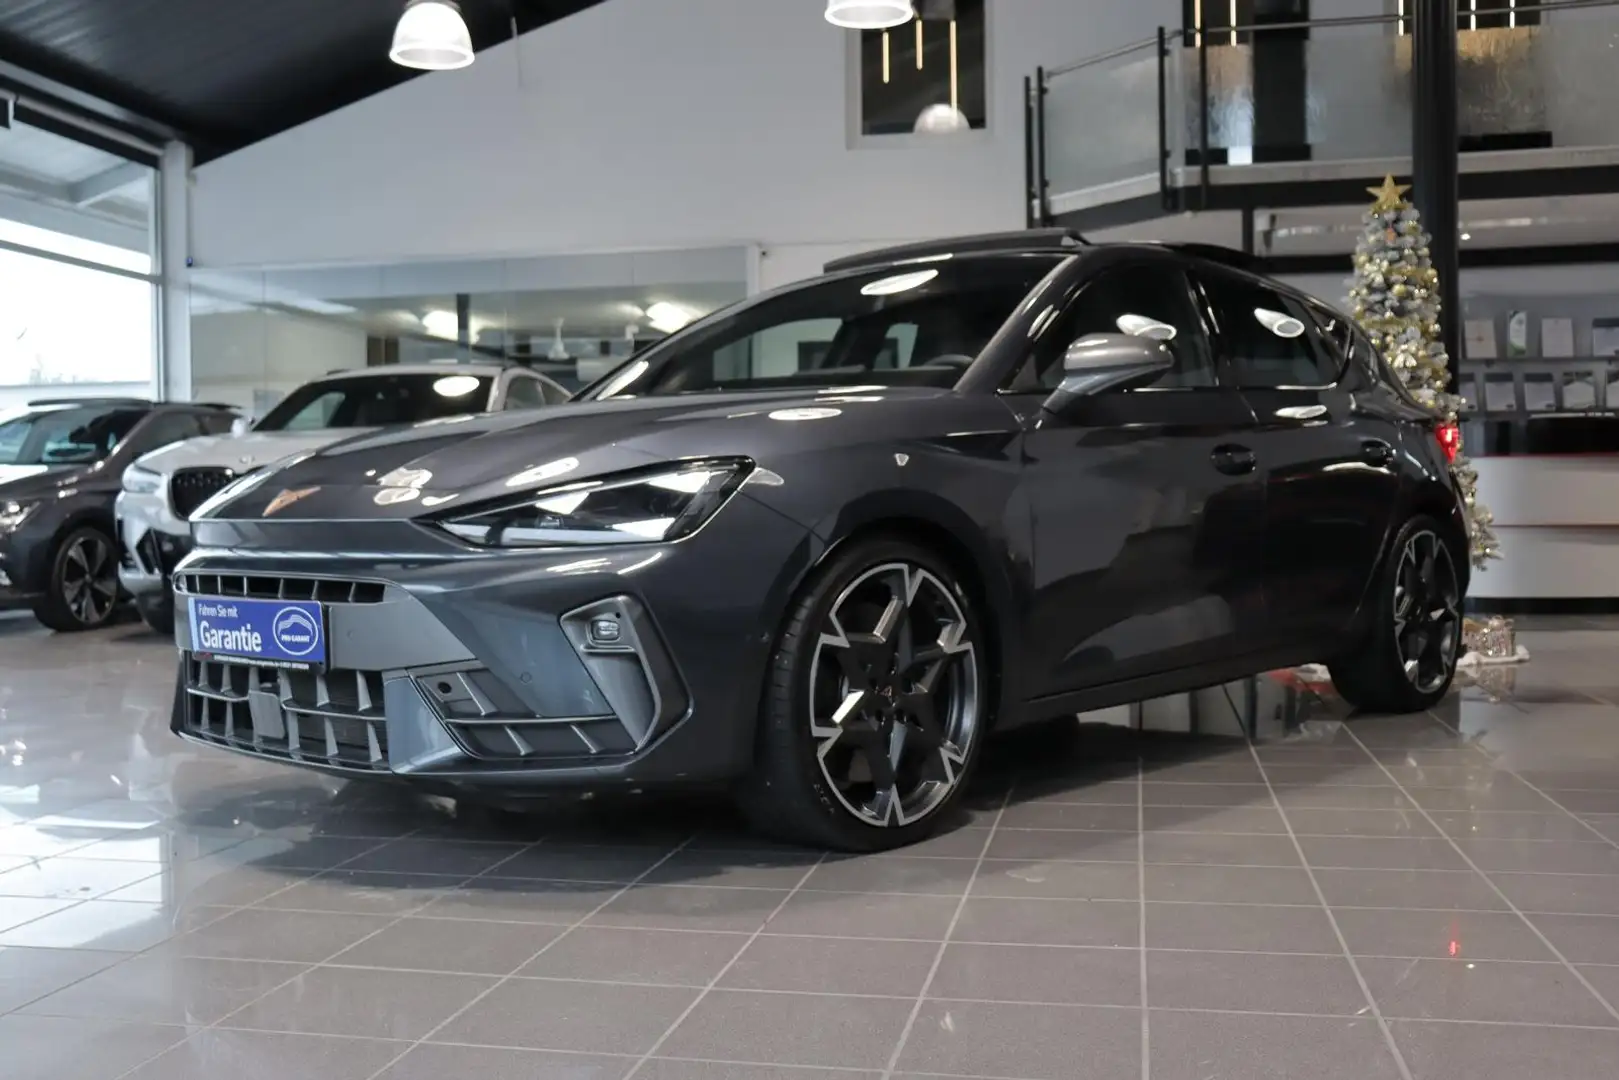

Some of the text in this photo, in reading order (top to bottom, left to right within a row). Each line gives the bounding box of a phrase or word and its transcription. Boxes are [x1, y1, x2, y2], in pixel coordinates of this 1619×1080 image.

[217, 604, 227, 618] Sie
[227, 605, 238, 618] mit
[200, 620, 262, 652] Garantie
